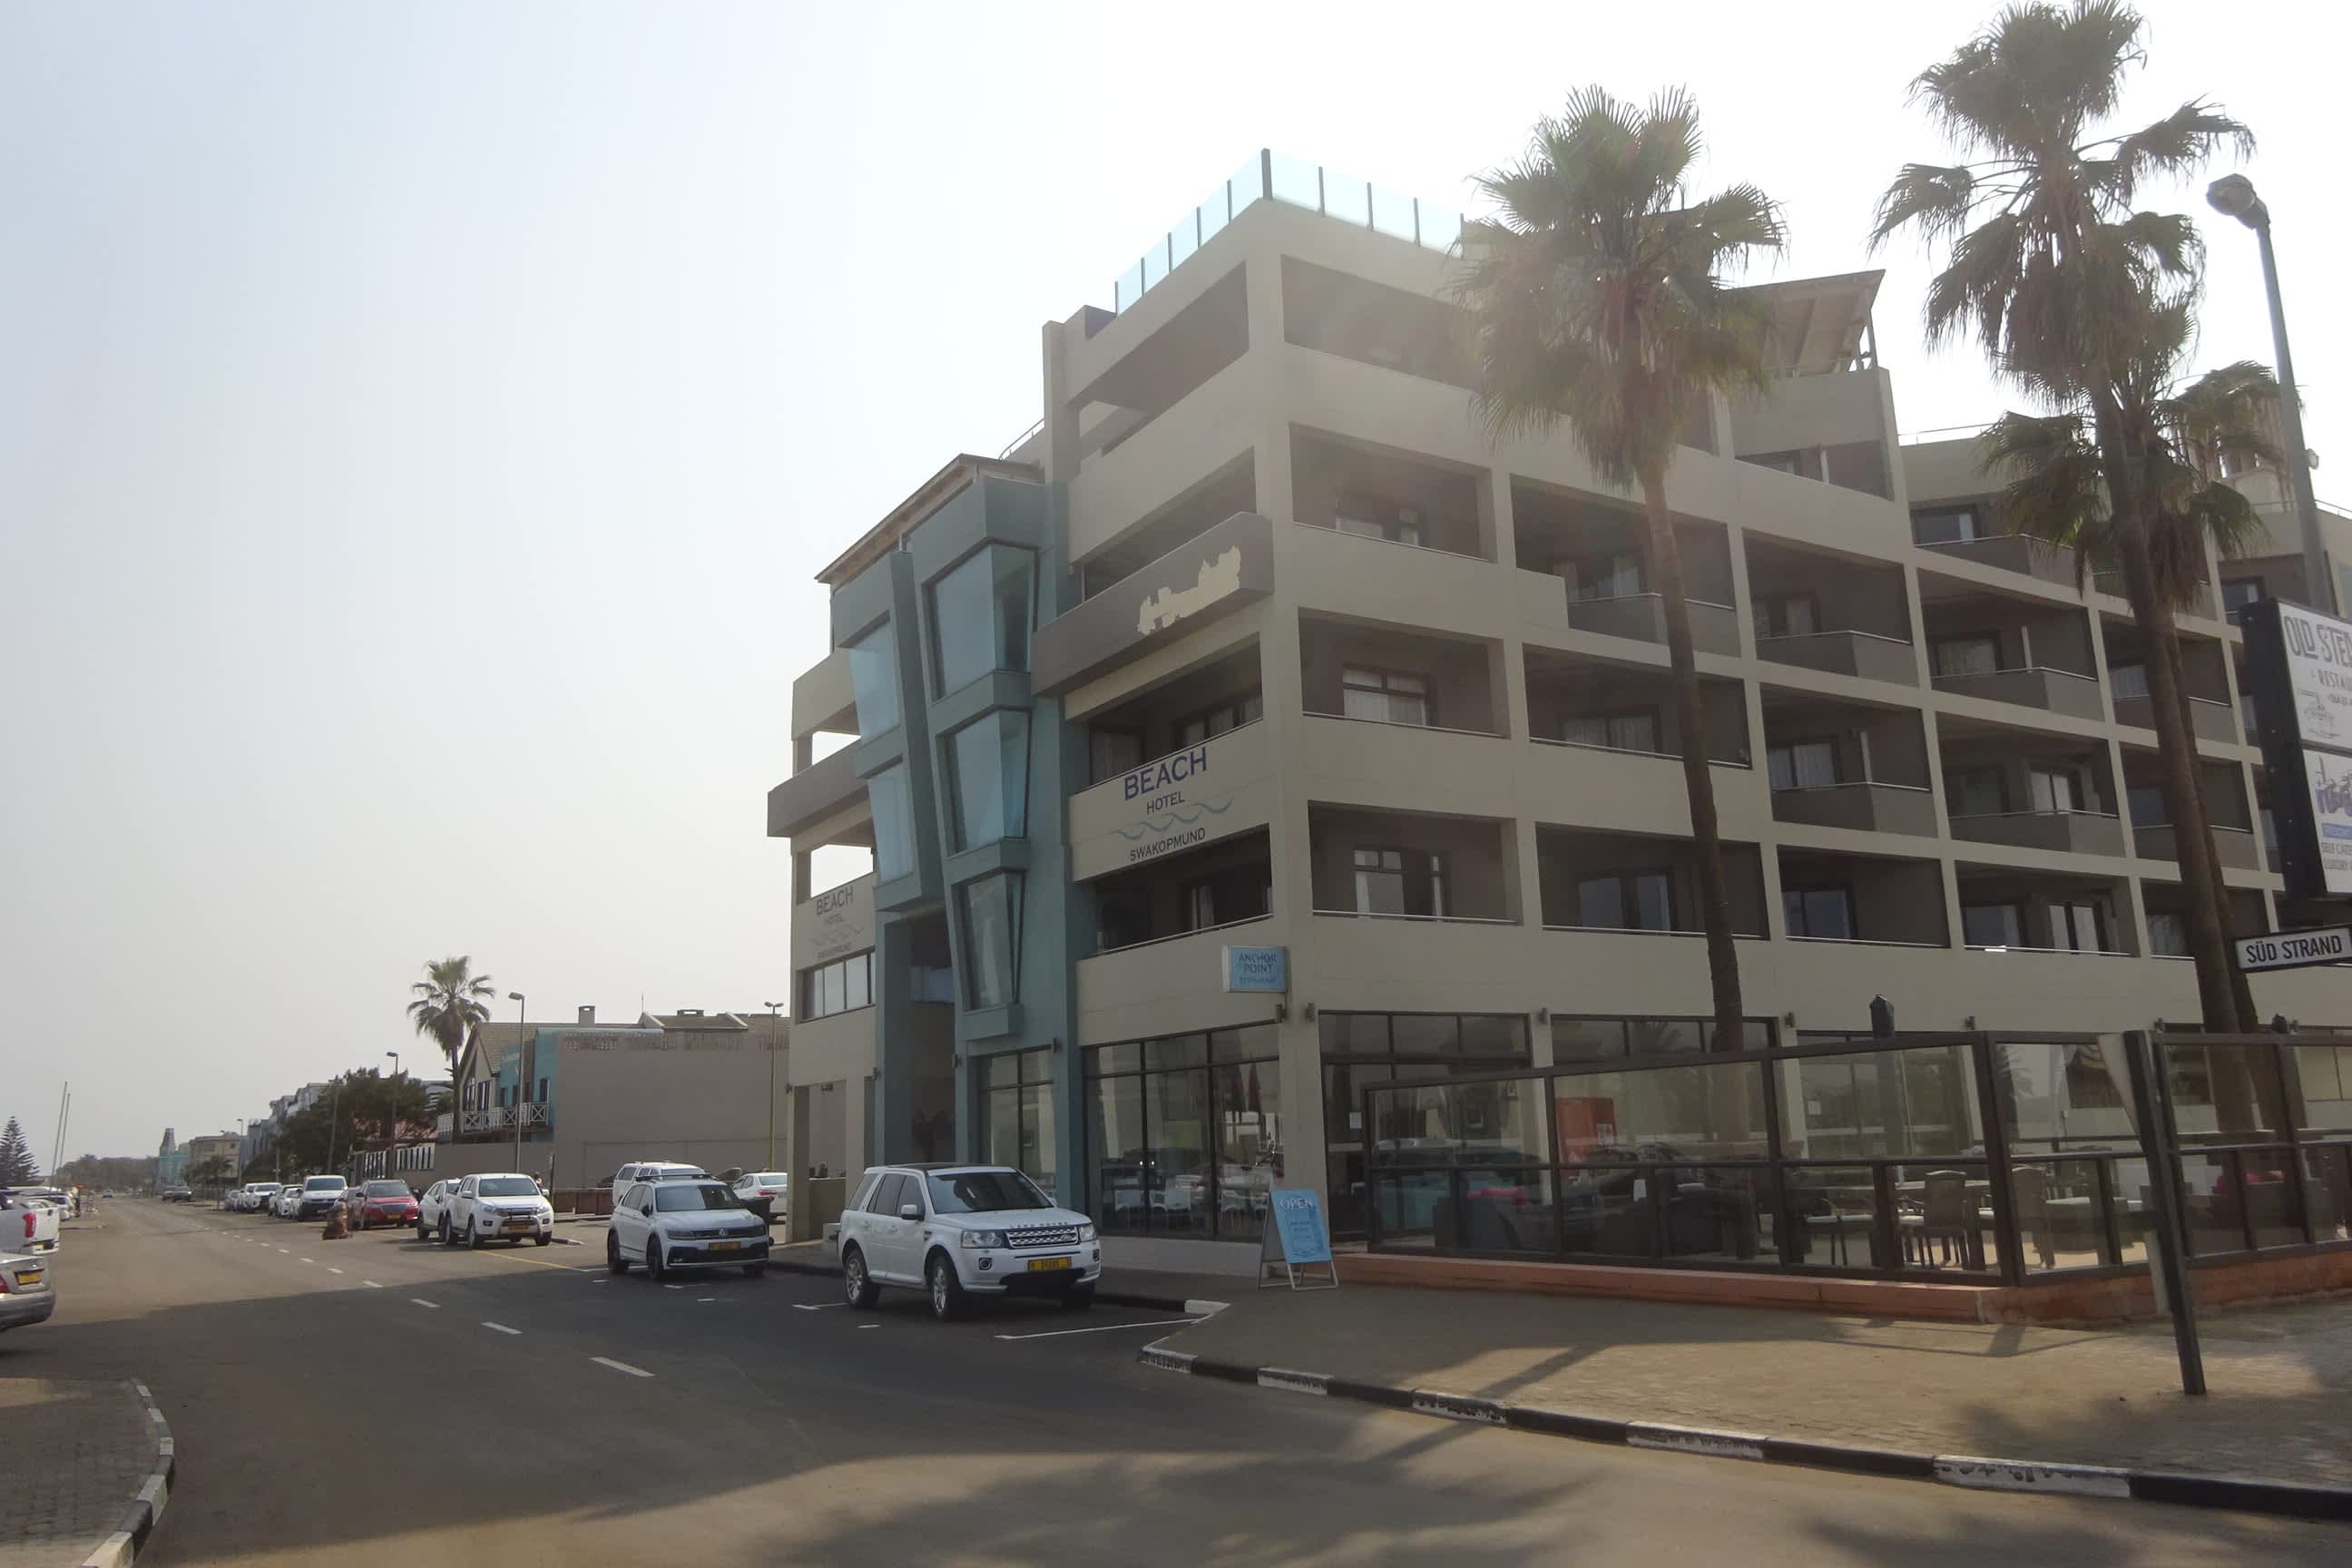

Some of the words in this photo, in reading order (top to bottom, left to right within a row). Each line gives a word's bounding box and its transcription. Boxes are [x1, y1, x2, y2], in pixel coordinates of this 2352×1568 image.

[2283, 615, 2318, 661] OLD
[1124, 747, 1208, 800] BEACH
[1146, 790, 1186, 815] HOTEL
[1130, 828, 1206, 861] SWAKOPMUND
[816, 886, 855, 916] BEACH
[1238, 953, 1278, 964] ANCHOR
[2246, 940, 2278, 963] SÜD
[2281, 935, 2343, 959] STRAND
[1243, 963, 1273, 974] POINT
[1279, 1197, 1314, 1210] OPEN
